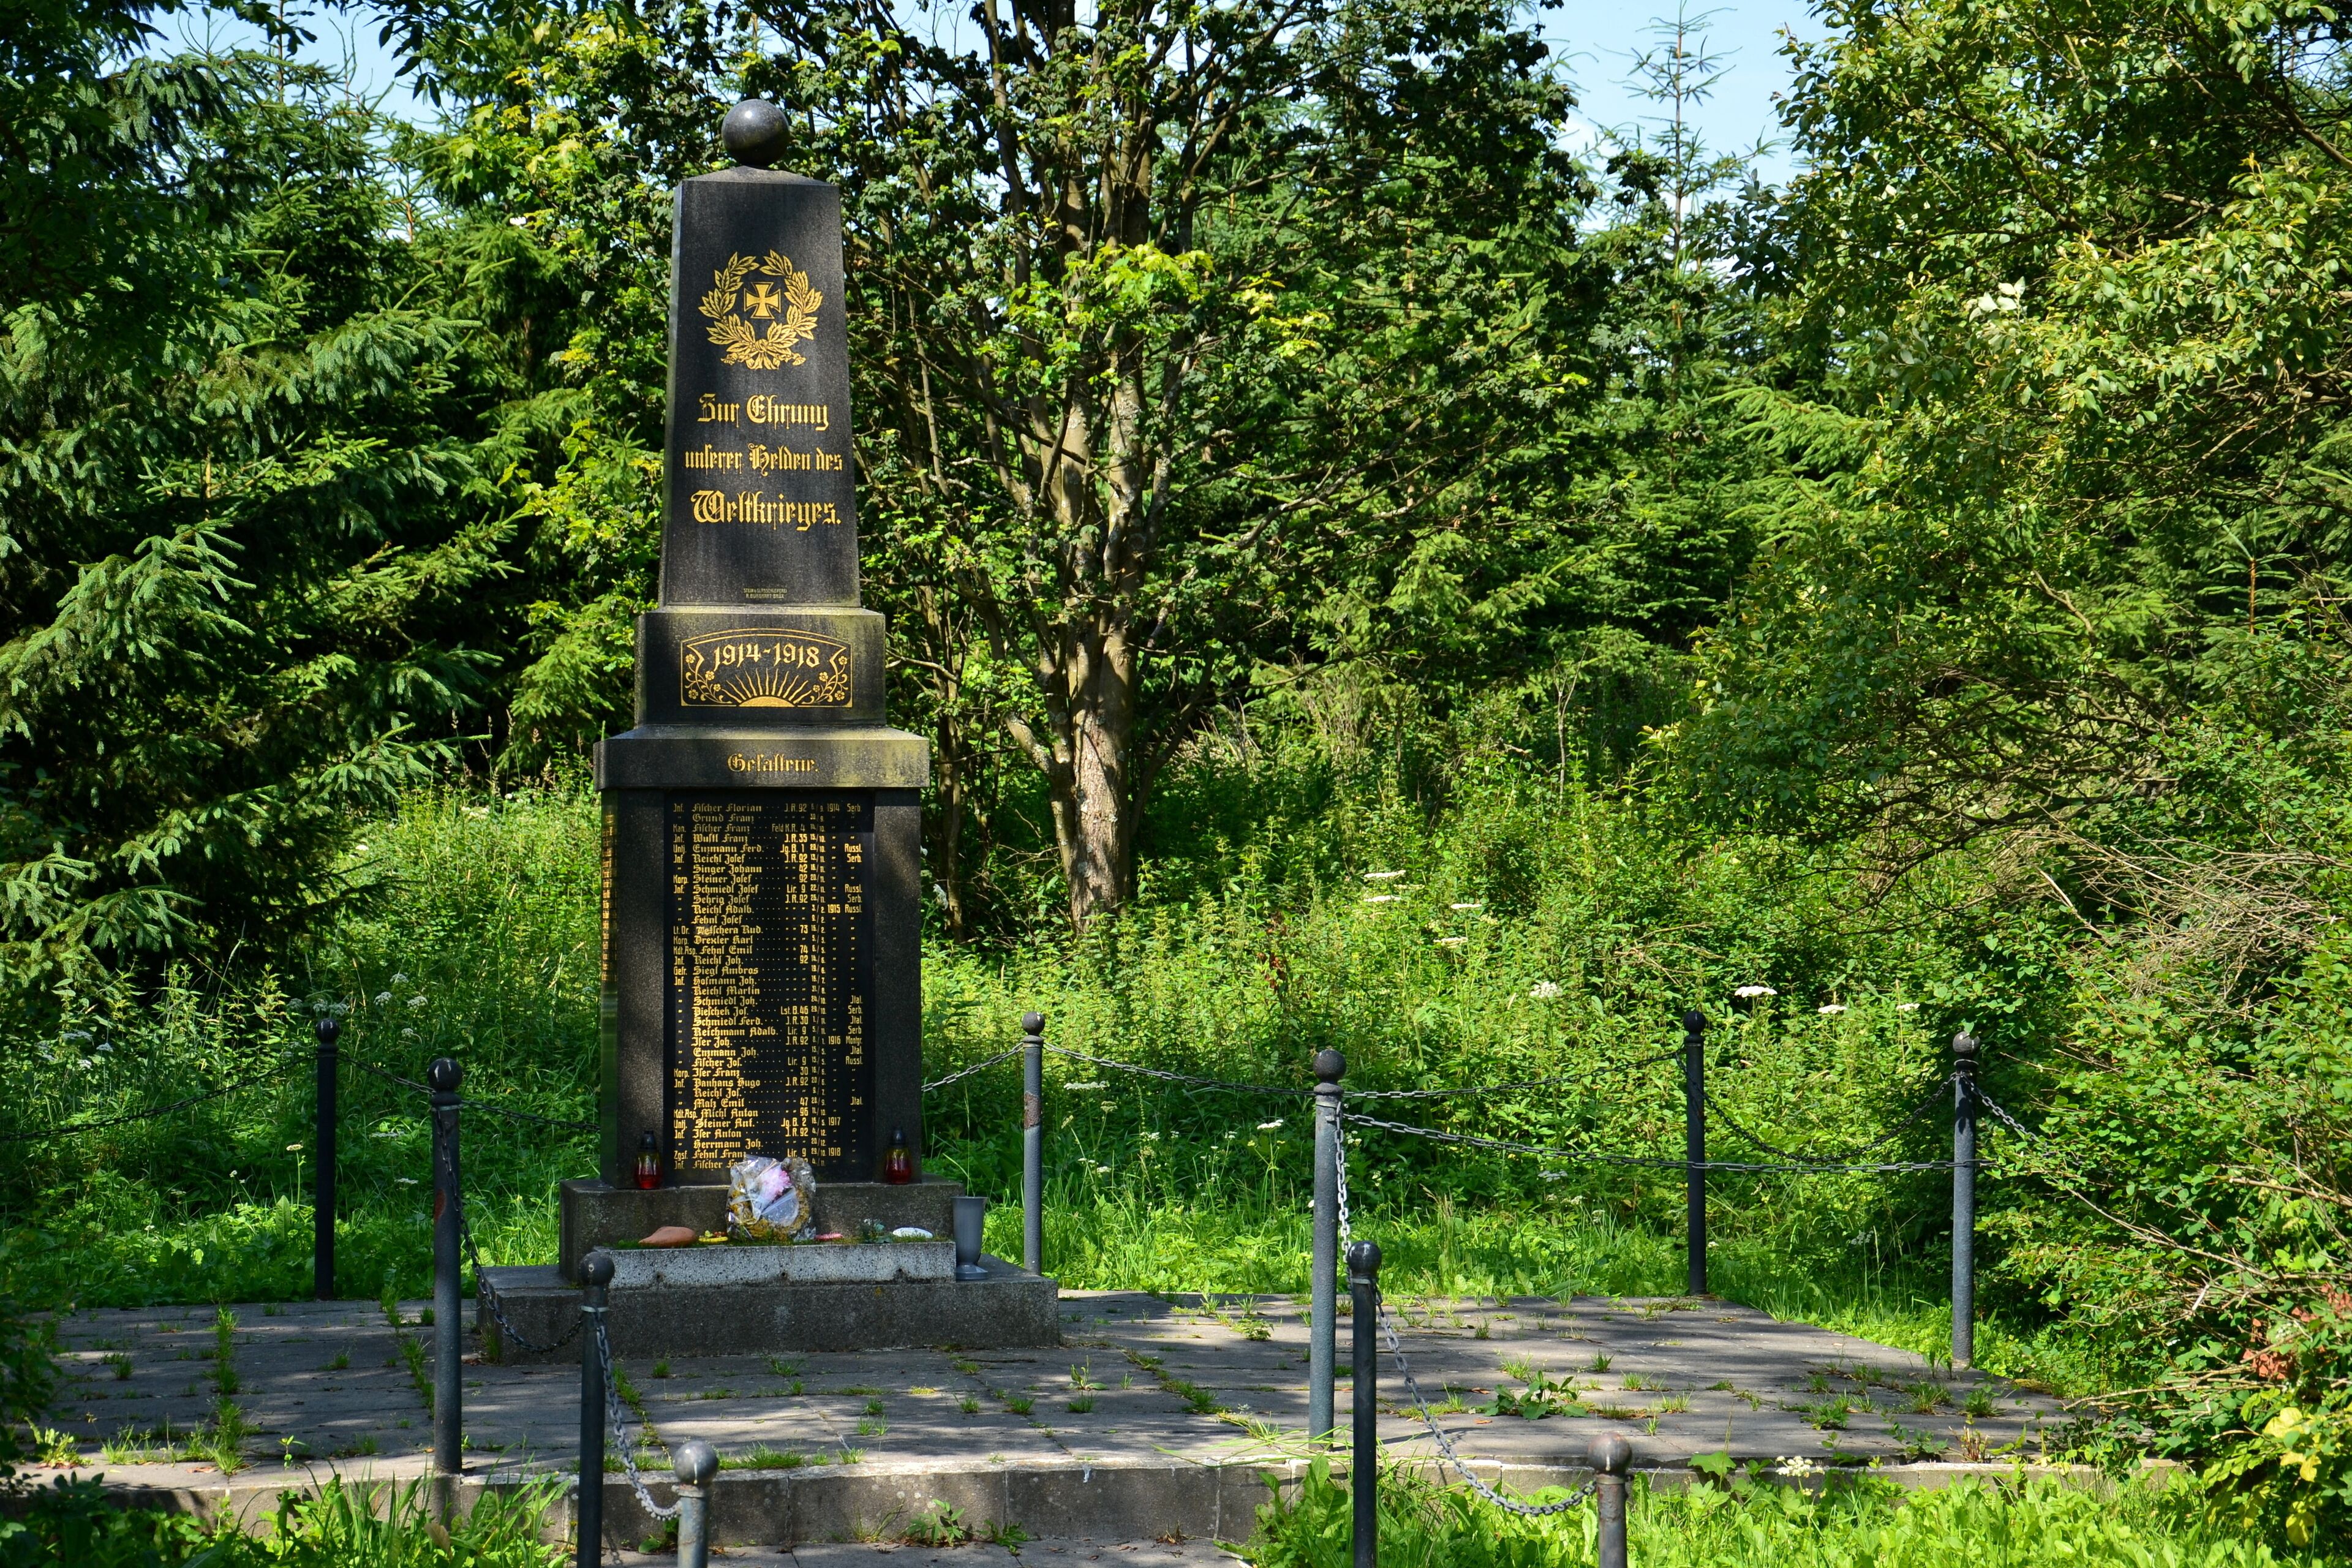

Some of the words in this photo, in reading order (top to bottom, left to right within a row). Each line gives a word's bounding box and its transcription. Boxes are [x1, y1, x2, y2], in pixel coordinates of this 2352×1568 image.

[697, 393, 740, 428] Zur
[746, 394, 829, 431] Ehrung
[747, 443, 811, 477] Helden
[816, 447, 843, 471] des
[690, 489, 842, 532] Weltkrieges.
[727, 753, 818, 773] Gefallene.
[726, 804, 761, 812] Florian
[827, 804, 839, 812] 1914
[693, 813, 723, 822] Grund
[728, 813, 754, 824] Franz
[673, 824, 686, 832] Kan.
[725, 824, 750, 834] Franz
[722, 834, 747, 844] Franz
[740, 844, 764, 853] Ferd.
[692, 854, 722, 864] Reichl
[847, 854, 862, 862] Serb.
[693, 864, 725, 875] Singer
[728, 864, 761, 875] Johann
[799, 864, 807, 873] 42
[693, 875, 728, 883] Steiner
[799, 874, 807, 883] 92
[693, 884, 734, 895] Schmiedl
[693, 895, 725, 905] Sehrig
[847, 894, 862, 903] Serb.
[692, 905, 722, 914] Reichl
[827, 905, 840, 913] 1915
[691, 915, 717, 924] Fehnl
[741, 925, 763, 934] Rud.
[800, 925, 808, 933] 73
[694, 935, 729, 944] Drexler
[733, 935, 753, 944] Karl
[699, 946, 724, 956] Fehnl
[729, 946, 752, 954] Emil
[800, 945, 808, 954] 74
[693, 956, 722, 966] Reichl
[725, 956, 743, 966] Joh.
[799, 956, 808, 964] 92
[693, 966, 718, 976] Siegl
[722, 966, 758, 976] Ambros
[739, 976, 756, 986] Joh.
[692, 987, 722, 995] Reichl
[726, 986, 760, 997] Martin
[693, 997, 736, 1007] Schmiedl
[740, 997, 758, 1006] Joh.
[848, 1006, 862, 1014] Serb.
[693, 1017, 736, 1027] Schmiedl
[739, 1017, 763, 1025] Ferd.
[692, 1027, 744, 1036] Reichmann
[714, 1037, 733, 1047] Joh.
[828, 1036, 840, 1045] 1916
[741, 1047, 759, 1057] Joh.
[713, 1068, 740, 1078] Franz
[800, 1067, 808, 1076] 30
[737, 1077, 760, 1088] Hugo
[693, 1088, 722, 1099] Reichl
[721, 1098, 744, 1107] Emil
[800, 1098, 808, 1106] 47
[701, 1109, 726, 1119] Michl
[731, 1108, 758, 1118] Anton
[800, 1107, 809, 1116] 96
[693, 1119, 731, 1128] Steiner
[735, 1118, 755, 1129] Ant.
[828, 1117, 840, 1126] 1917
[714, 1129, 741, 1139] Anton
[693, 1139, 741, 1149] Herrmann
[745, 1139, 763, 1149] Joh.
[692, 1150, 718, 1159] Fehnl
[828, 1148, 840, 1156] 1918
